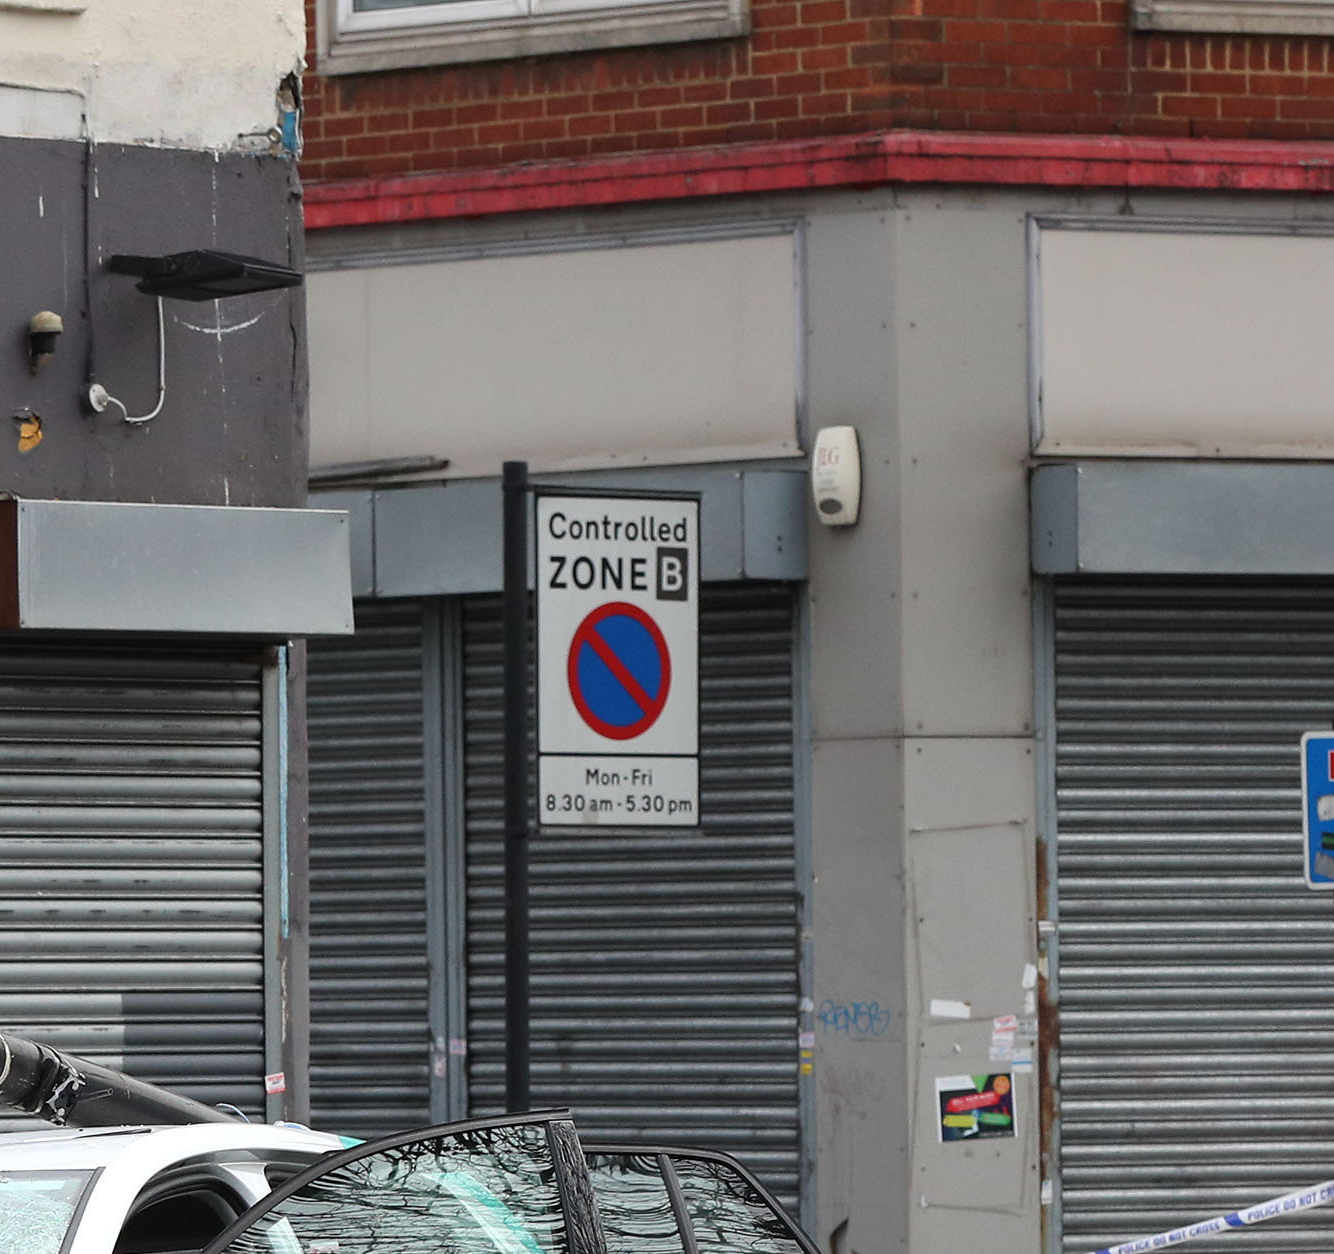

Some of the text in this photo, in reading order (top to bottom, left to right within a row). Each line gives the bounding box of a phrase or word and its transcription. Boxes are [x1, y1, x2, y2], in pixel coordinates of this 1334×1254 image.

[548, 512, 688, 543] Controlled
[548, 555, 684, 593] ZONE B
[546, 795, 586, 813] 8.30
[589, 799, 613, 813] am
[626, 795, 666, 813] 5.30
[669, 800, 693, 815] pm
[1247, 1203, 1281, 1222] POLICE
[1283, 1198, 1298, 1211] DO
[1299, 1191, 1319, 1207] NOT
[1152, 1234, 1167, 1248] DO
[1168, 1228, 1188, 1243] NOT
[1189, 1221, 1221, 1238] CROSS
